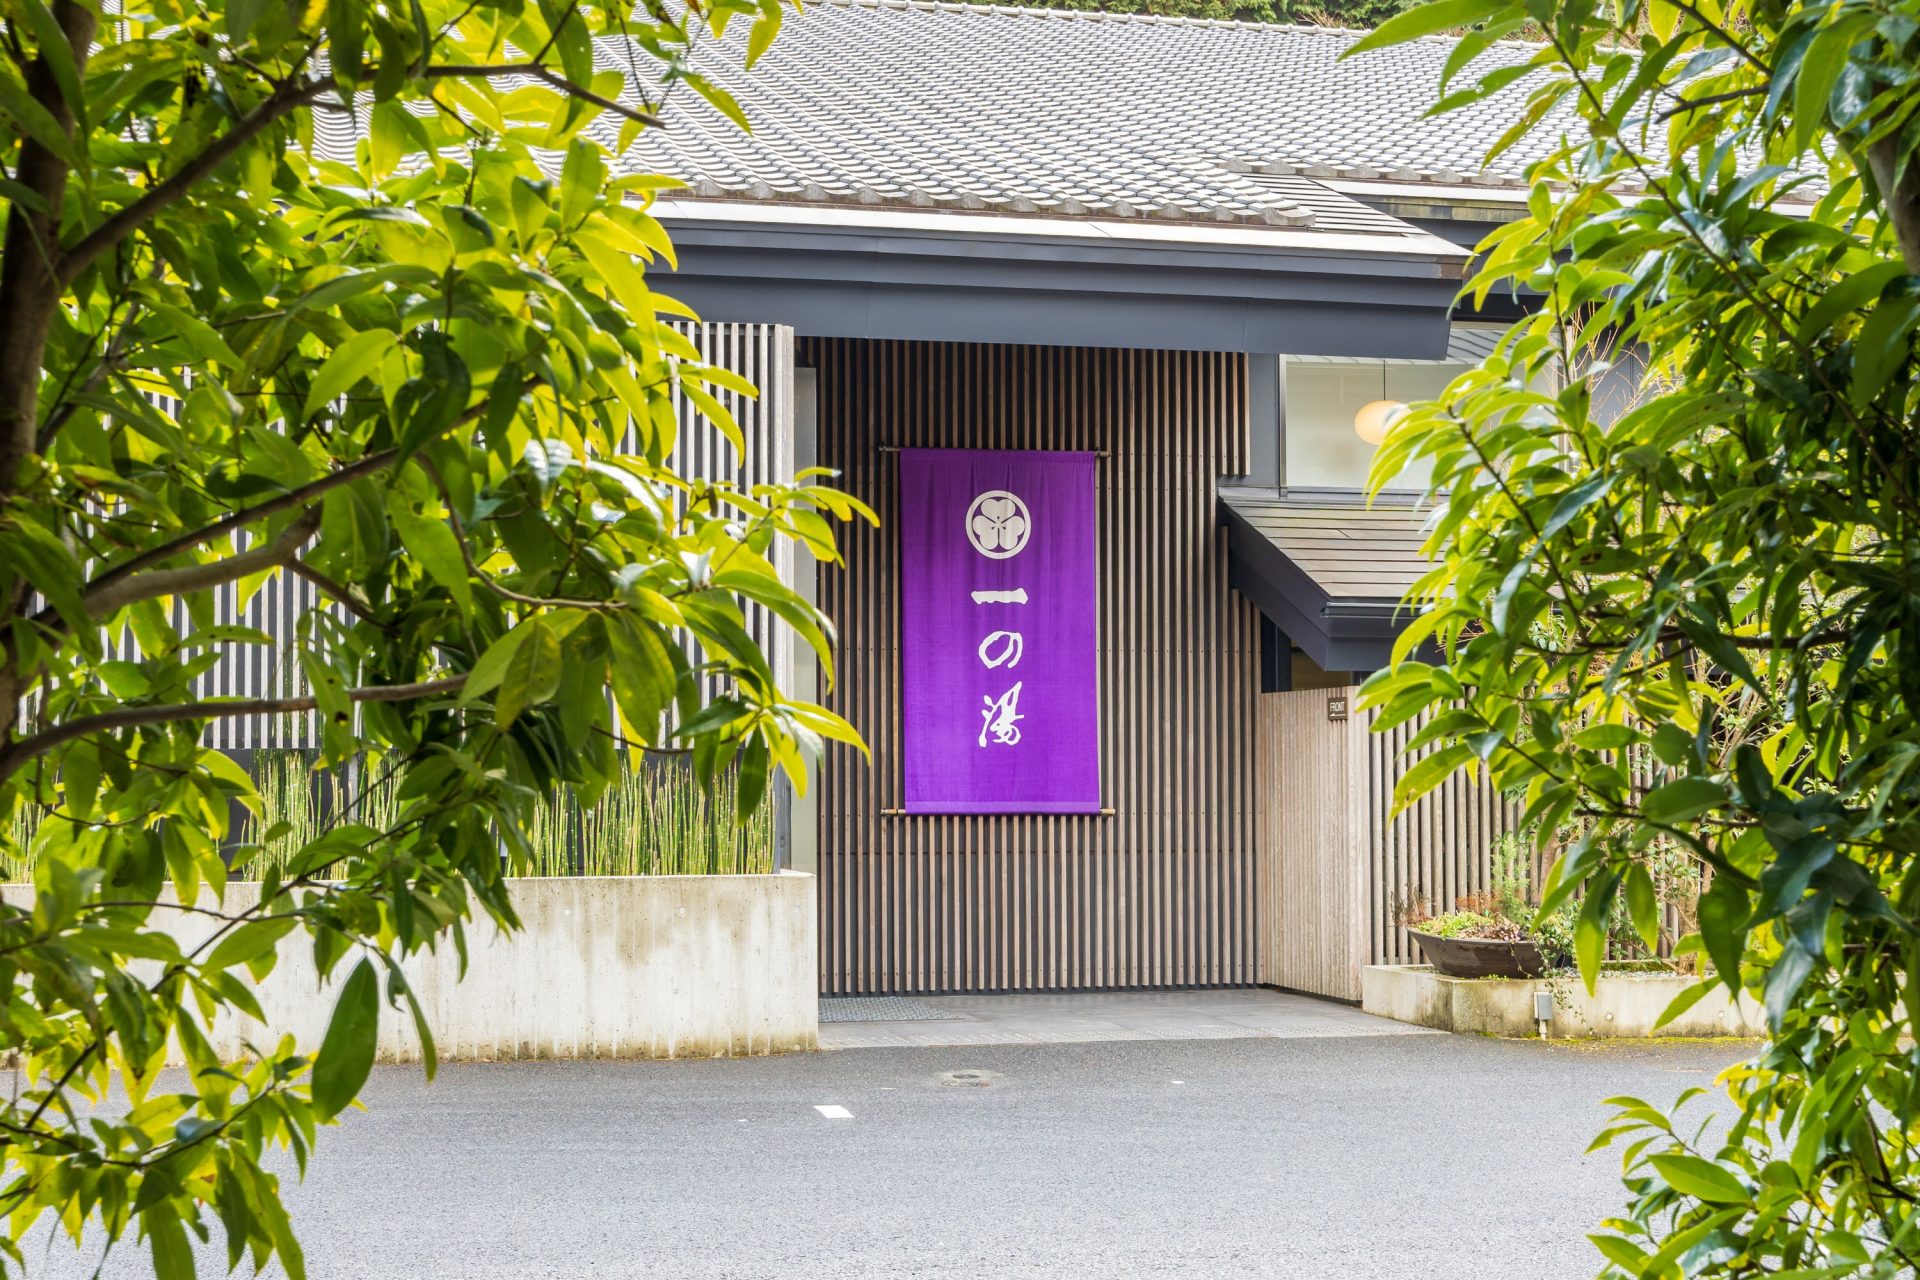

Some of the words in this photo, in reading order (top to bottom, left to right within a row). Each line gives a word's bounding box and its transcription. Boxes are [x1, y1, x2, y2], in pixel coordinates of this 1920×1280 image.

[970, 587, 1029, 748] 一の湯
[1329, 701, 1345, 712] FRONT
